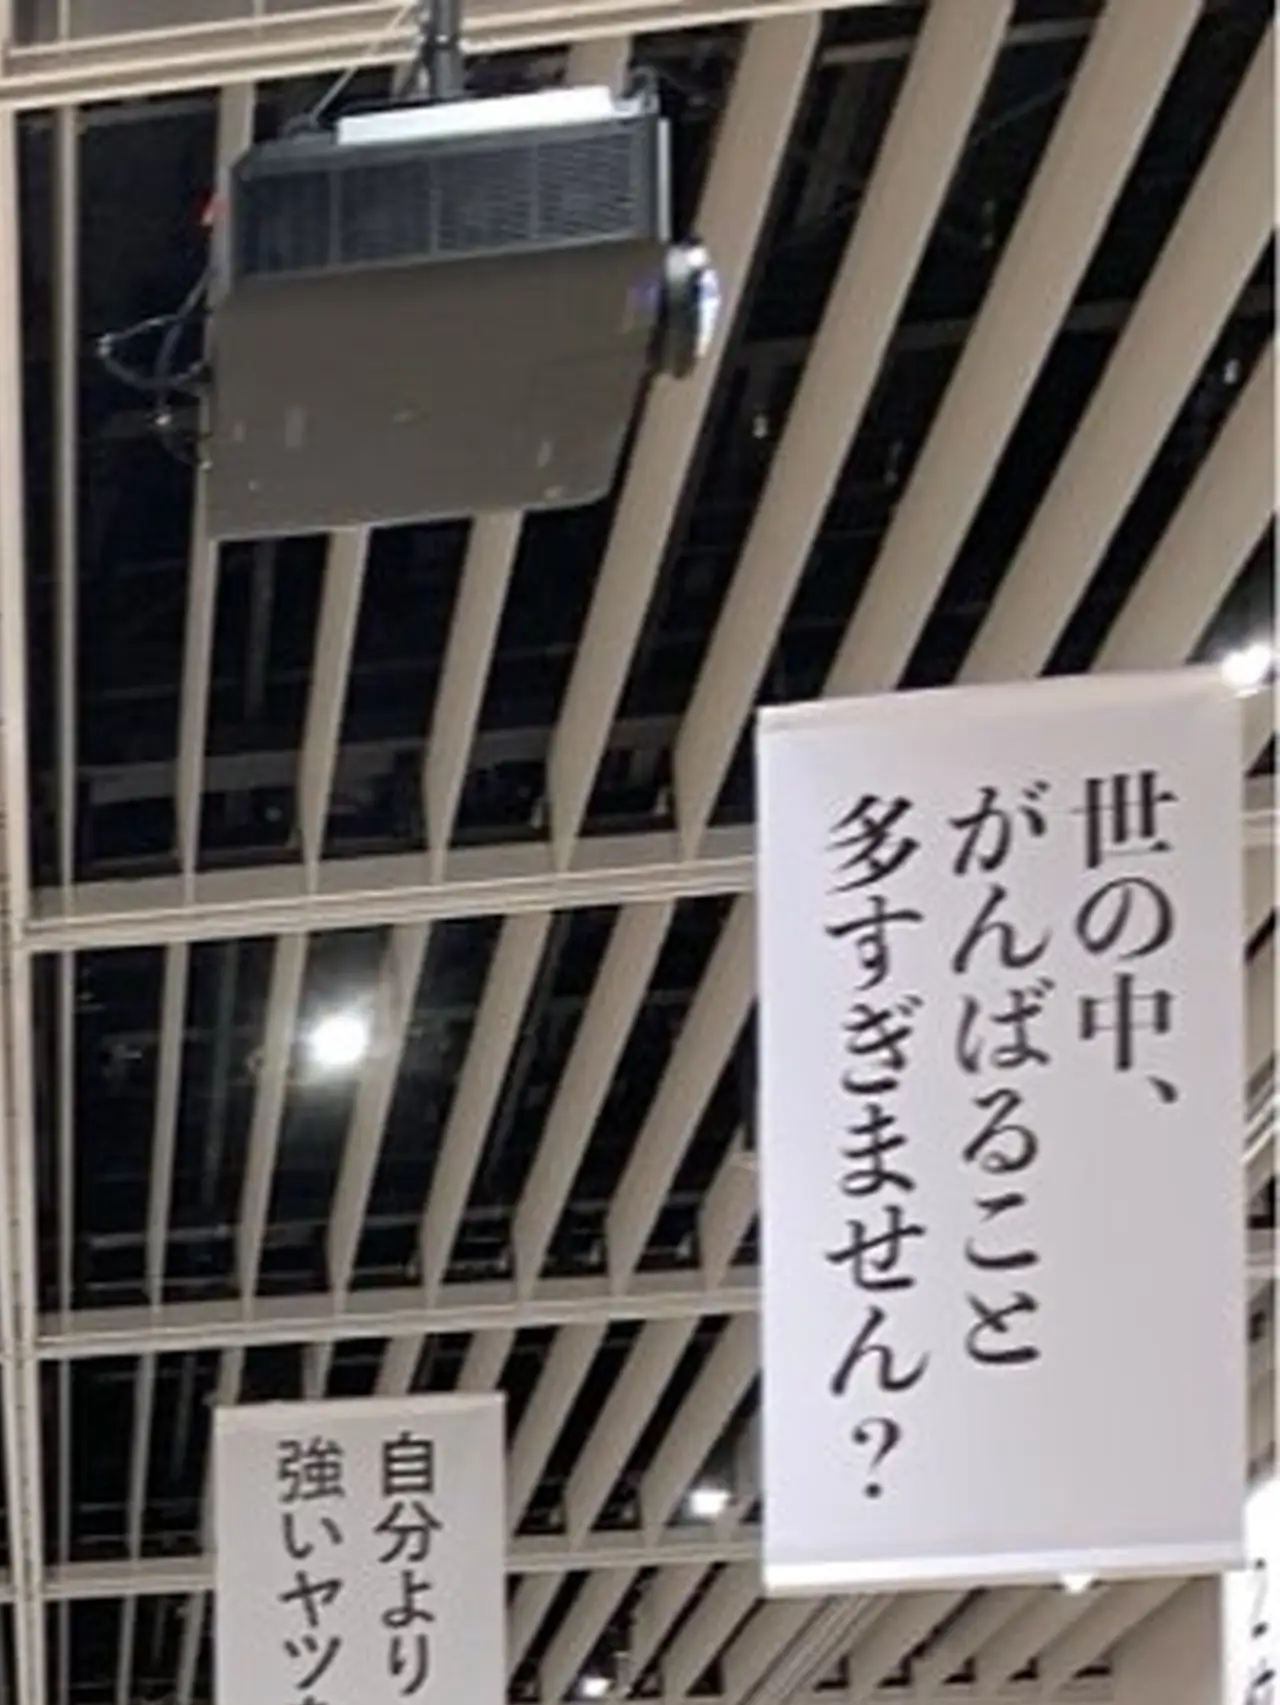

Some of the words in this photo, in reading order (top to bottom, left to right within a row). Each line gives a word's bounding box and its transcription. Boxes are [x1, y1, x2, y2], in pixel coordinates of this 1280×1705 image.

[825, 792, 930, 1499] 多すぎません？
[948, 780, 1051, 1367] がんばること
[1071, 768, 1180, 1106] 世の中、
[373, 1430, 443, 1696] 自分より
